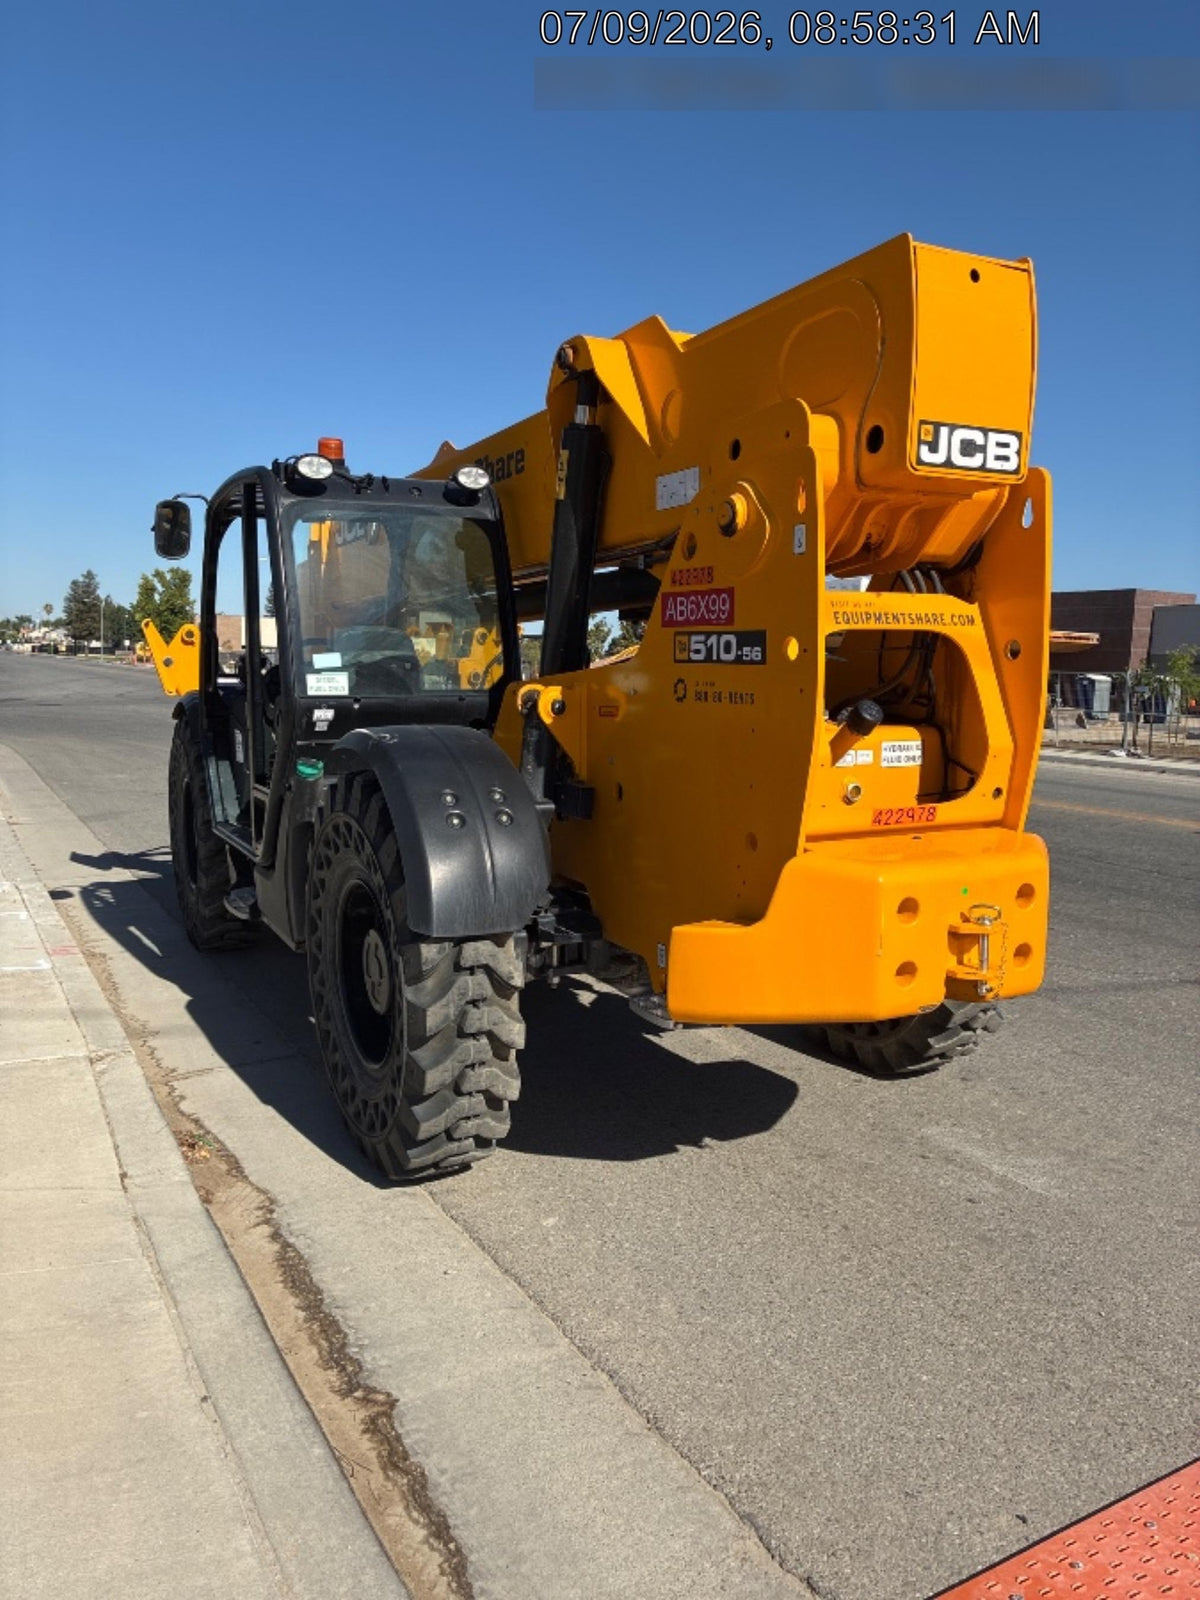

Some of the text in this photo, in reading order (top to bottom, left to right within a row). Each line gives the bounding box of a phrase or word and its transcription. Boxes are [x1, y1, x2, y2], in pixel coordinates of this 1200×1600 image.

[919, 426, 1020, 472] JCB
[664, 593, 730, 621] AB6X99
[833, 611, 976, 627] EQUIPMENTSHARE.COM
[872, 806, 937, 826] 422978
